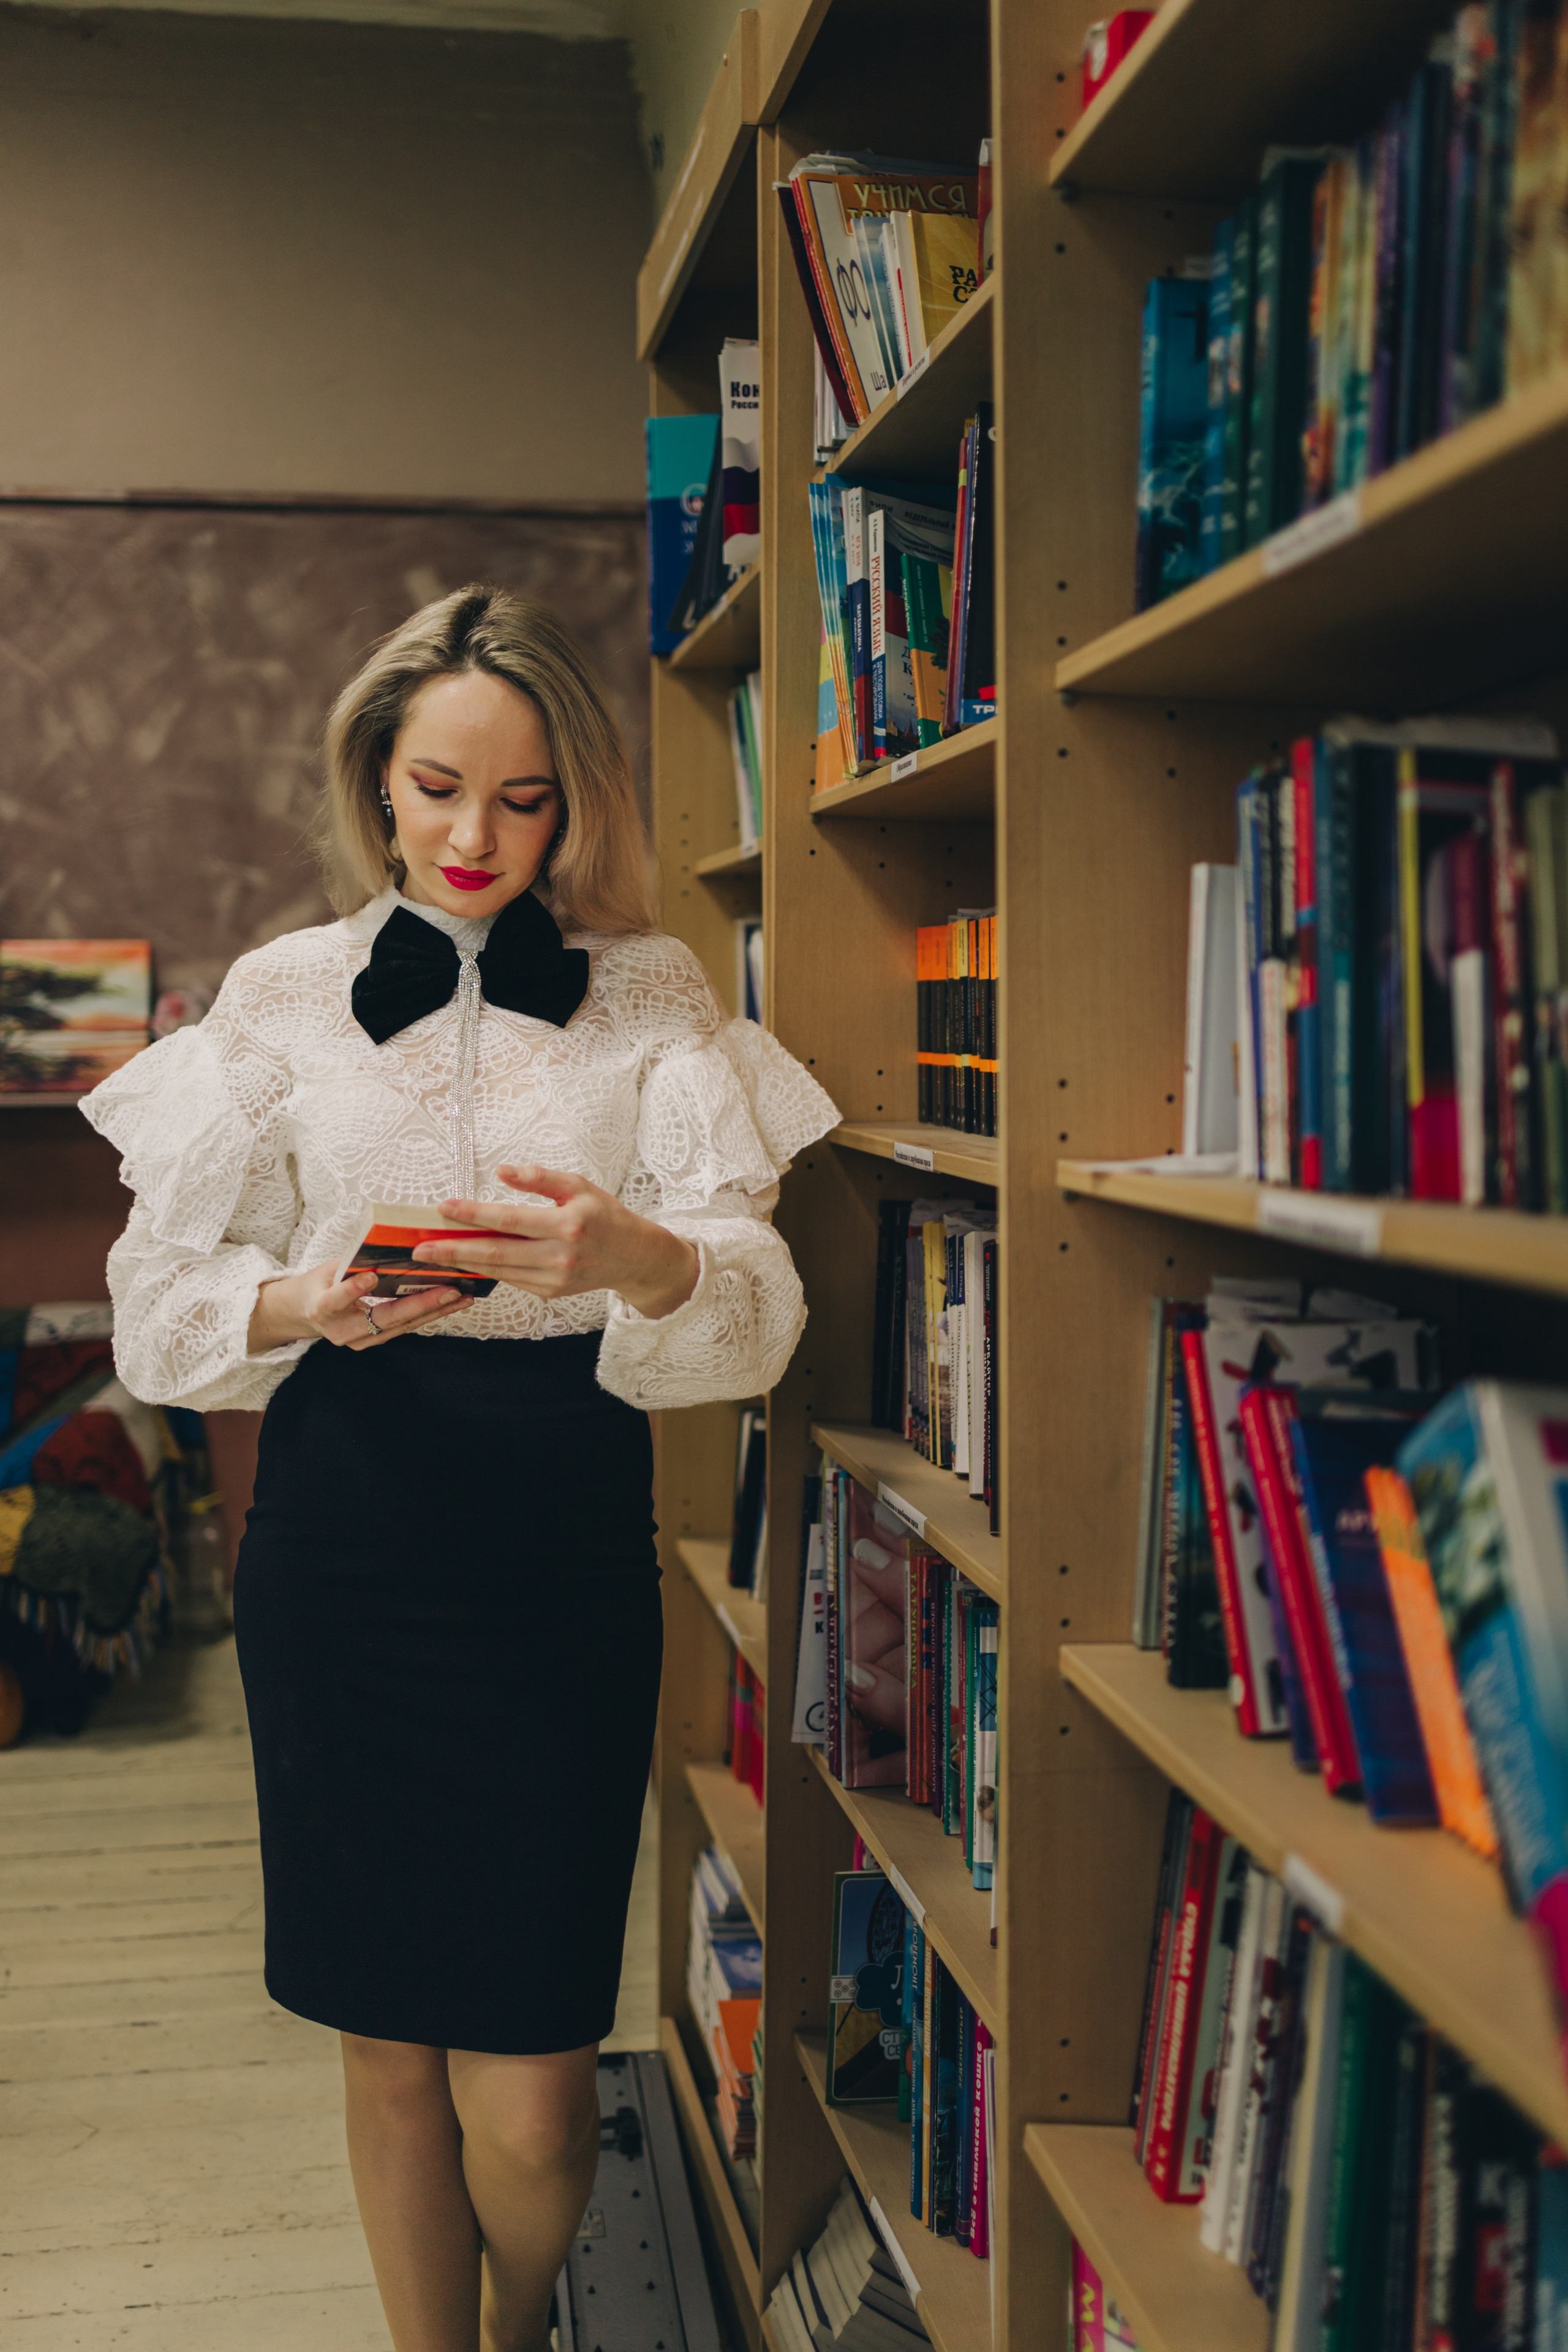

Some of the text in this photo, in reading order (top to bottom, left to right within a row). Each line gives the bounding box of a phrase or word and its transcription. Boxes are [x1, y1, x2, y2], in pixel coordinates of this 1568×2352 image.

[853, 183, 967, 210] УЧИМСЯ
[949, 265, 978, 287] РА
[730, 382, 759, 398] Кон
[870, 371, 886, 391] Ша
[731, 399, 759, 410] Росси
[870, 555, 882, 656] РУССКИЙ ЯЗЫК
[922, 1987, 931, 2057] КАПИТАЛЬНЫЙ
[971, 2106, 980, 2191] сиамской
